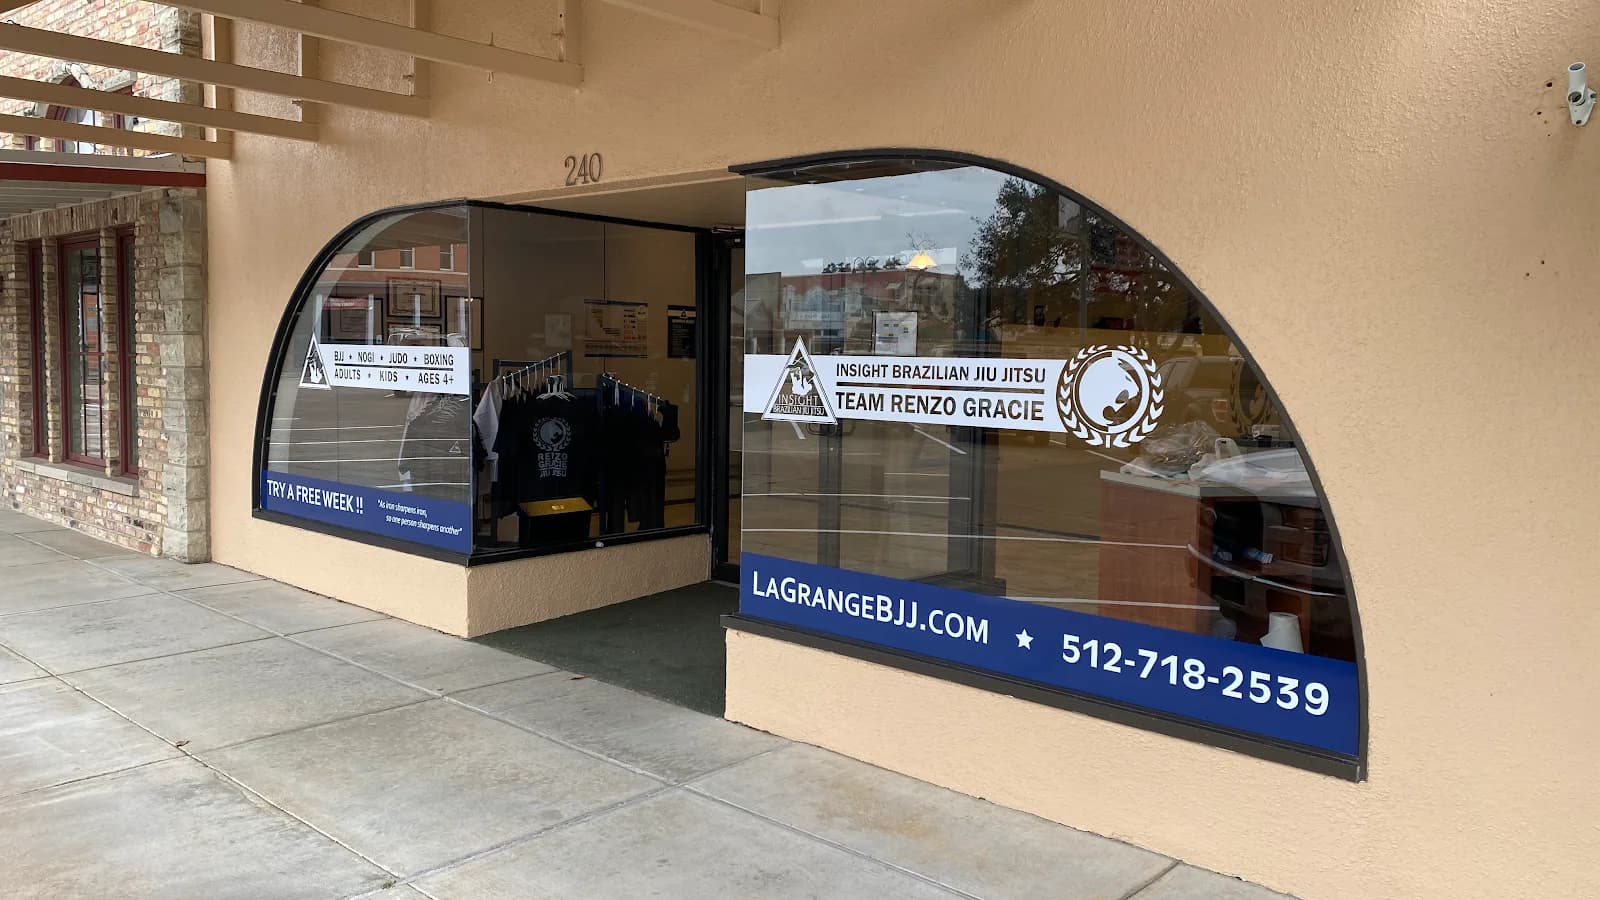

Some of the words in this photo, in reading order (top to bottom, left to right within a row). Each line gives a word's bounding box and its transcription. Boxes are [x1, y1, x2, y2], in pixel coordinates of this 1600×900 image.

[564, 152, 603, 186] 240
[334, 350, 345, 362] BJJ
[358, 351, 375, 363] NOGI
[388, 352, 408, 364] JUDO
[423, 353, 454, 366] BOXING
[334, 368, 361, 380] ADULTS
[379, 370, 398, 382] KIDS
[418, 372, 440, 385] AGES
[442, 373, 455, 385] 4+
[836, 363, 889, 378] INSIGHT
[892, 364, 970, 381] BRAZILIAN
[973, 366, 997, 382] JIU
[1001, 367, 1046, 384] JITSU
[778, 394, 819, 406] INSIGHT
[835, 391, 885, 412] TEAM
[891, 394, 957, 416] RENZO
[962, 397, 1045, 421] GRACIE
[266, 479, 287, 499] TRY
[287, 484, 295, 500] A
[296, 485, 321, 506] FREE
[322, 492, 354, 513] WEEK
[356, 497, 364, 515] !!
[395, 503, 417, 514] sharpens
[391, 516, 401, 524] one
[400, 518, 417, 527] person
[417, 519, 440, 532] sharpens
[1062, 633, 1330, 716] 512-718-2539
